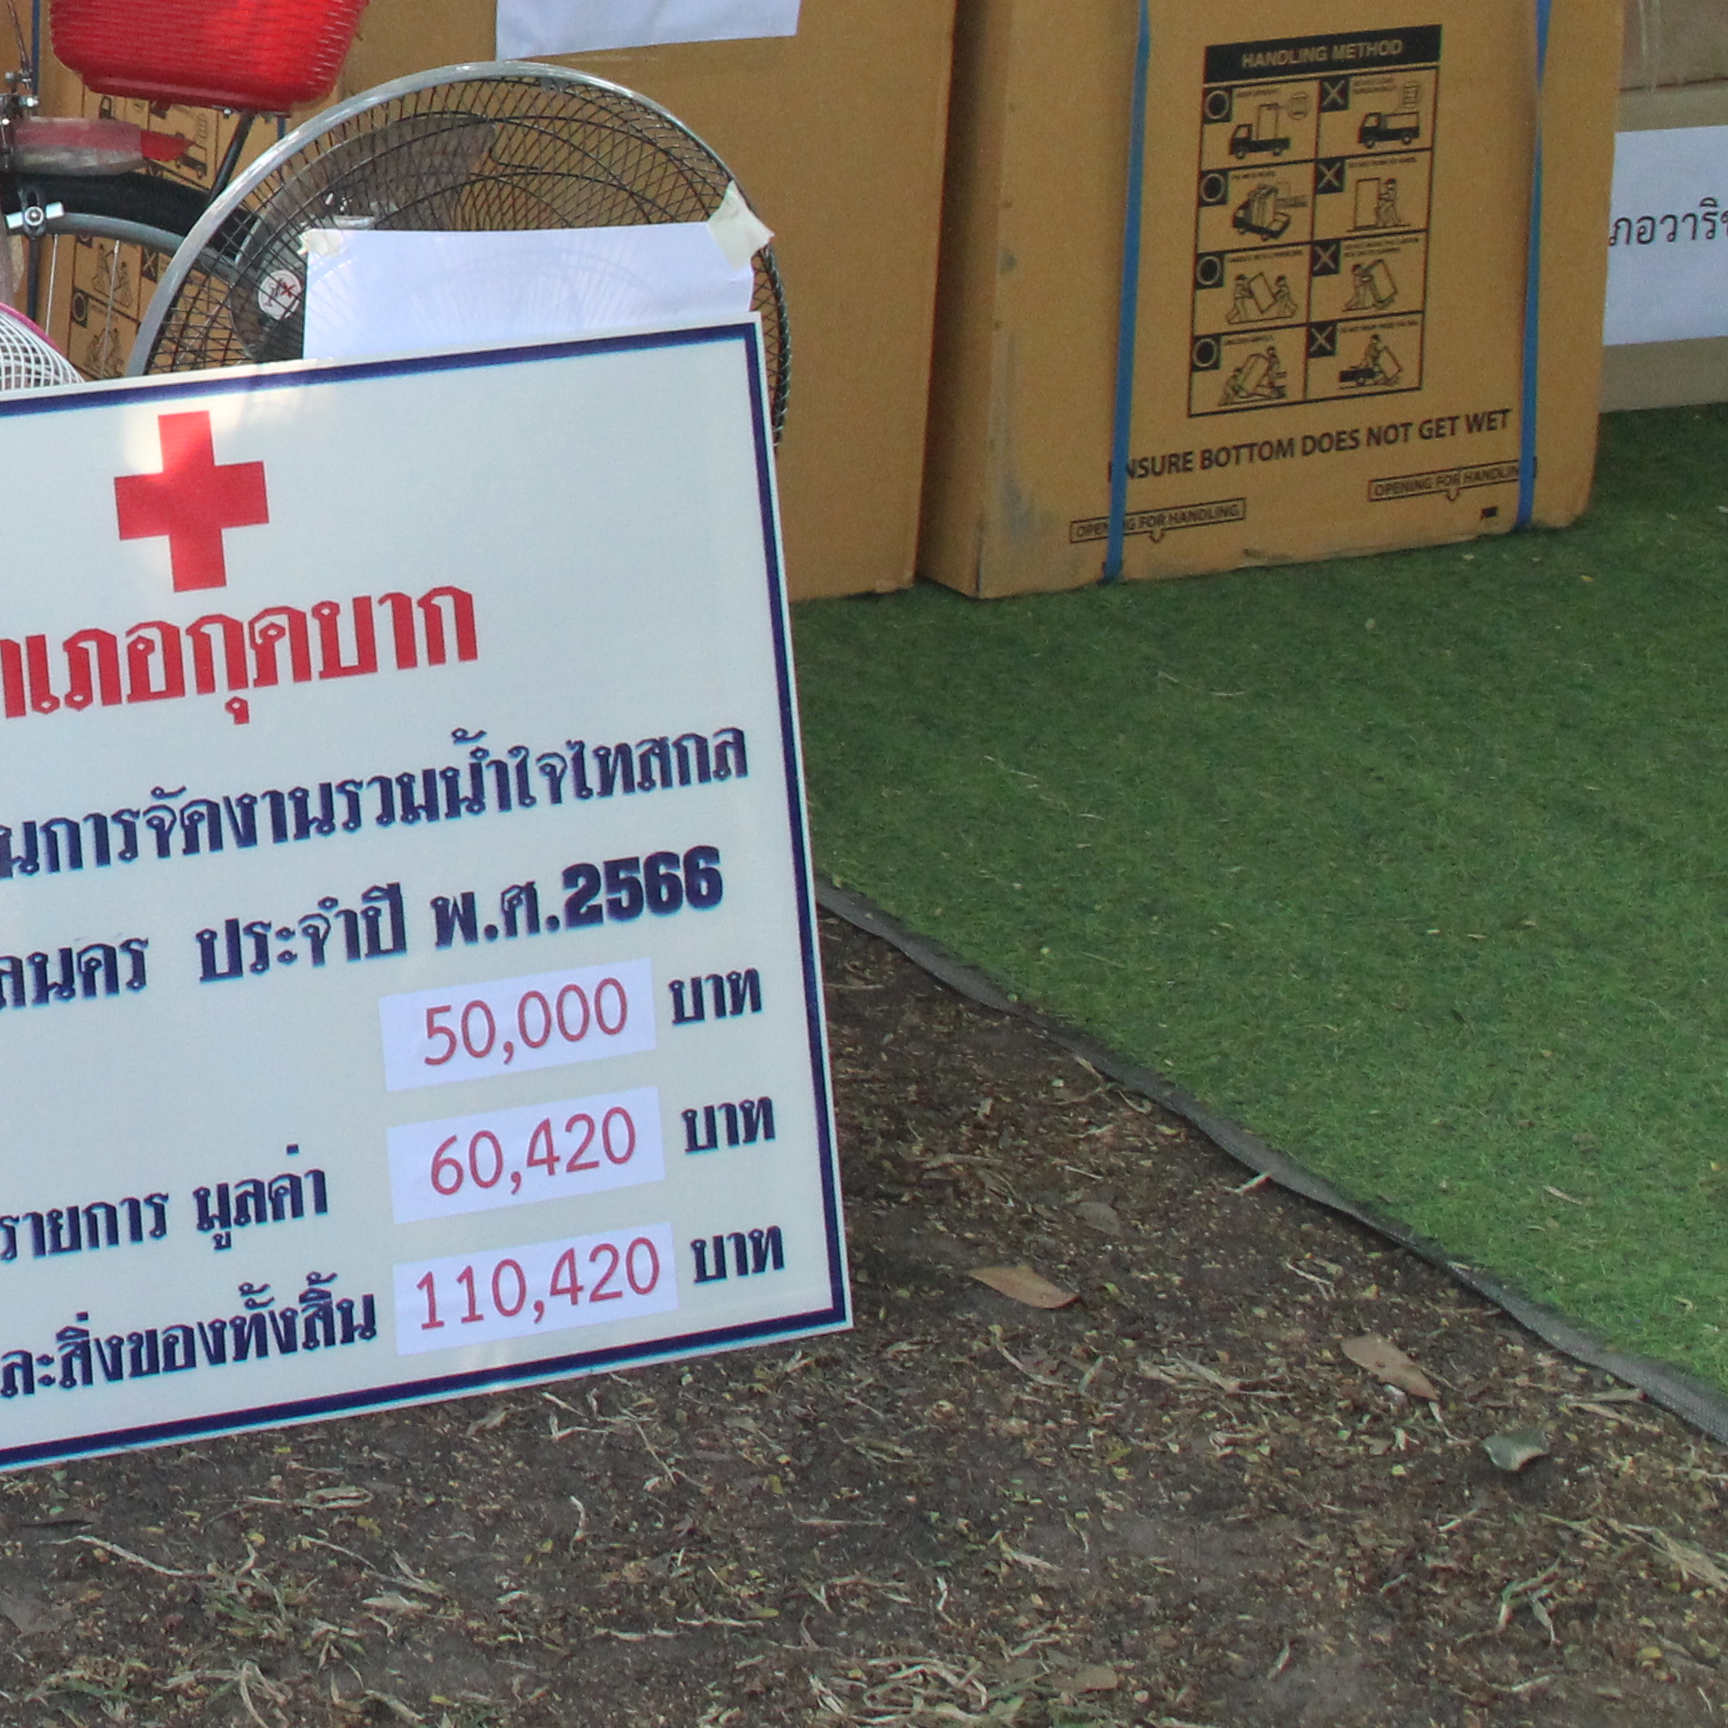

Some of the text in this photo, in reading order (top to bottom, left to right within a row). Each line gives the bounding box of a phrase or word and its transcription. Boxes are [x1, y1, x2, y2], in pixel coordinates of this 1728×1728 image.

[1241, 39, 1404, 69] HANDLING METHOD
[1109, 408, 1512, 483] NSURE BOTTOM DOES NOT GET WET
[1373, 461, 1524, 498] OPENING FOR HANDLIN
[1075, 503, 1241, 539] OPENG FOR HANDLING
[196, 880, 408, 984] ประจำปี
[431, 845, 725, 951] พ.ศ.2566
[424, 976, 629, 1067] 50,000
[669, 966, 763, 1026] บาท
[193, 1143, 330, 1251] มูลค่า
[430, 1105, 637, 1197] 60,420
[682, 1095, 776, 1154] บาท
[416, 1235, 661, 1331] 110,420
[691, 1223, 786, 1285] บาท
